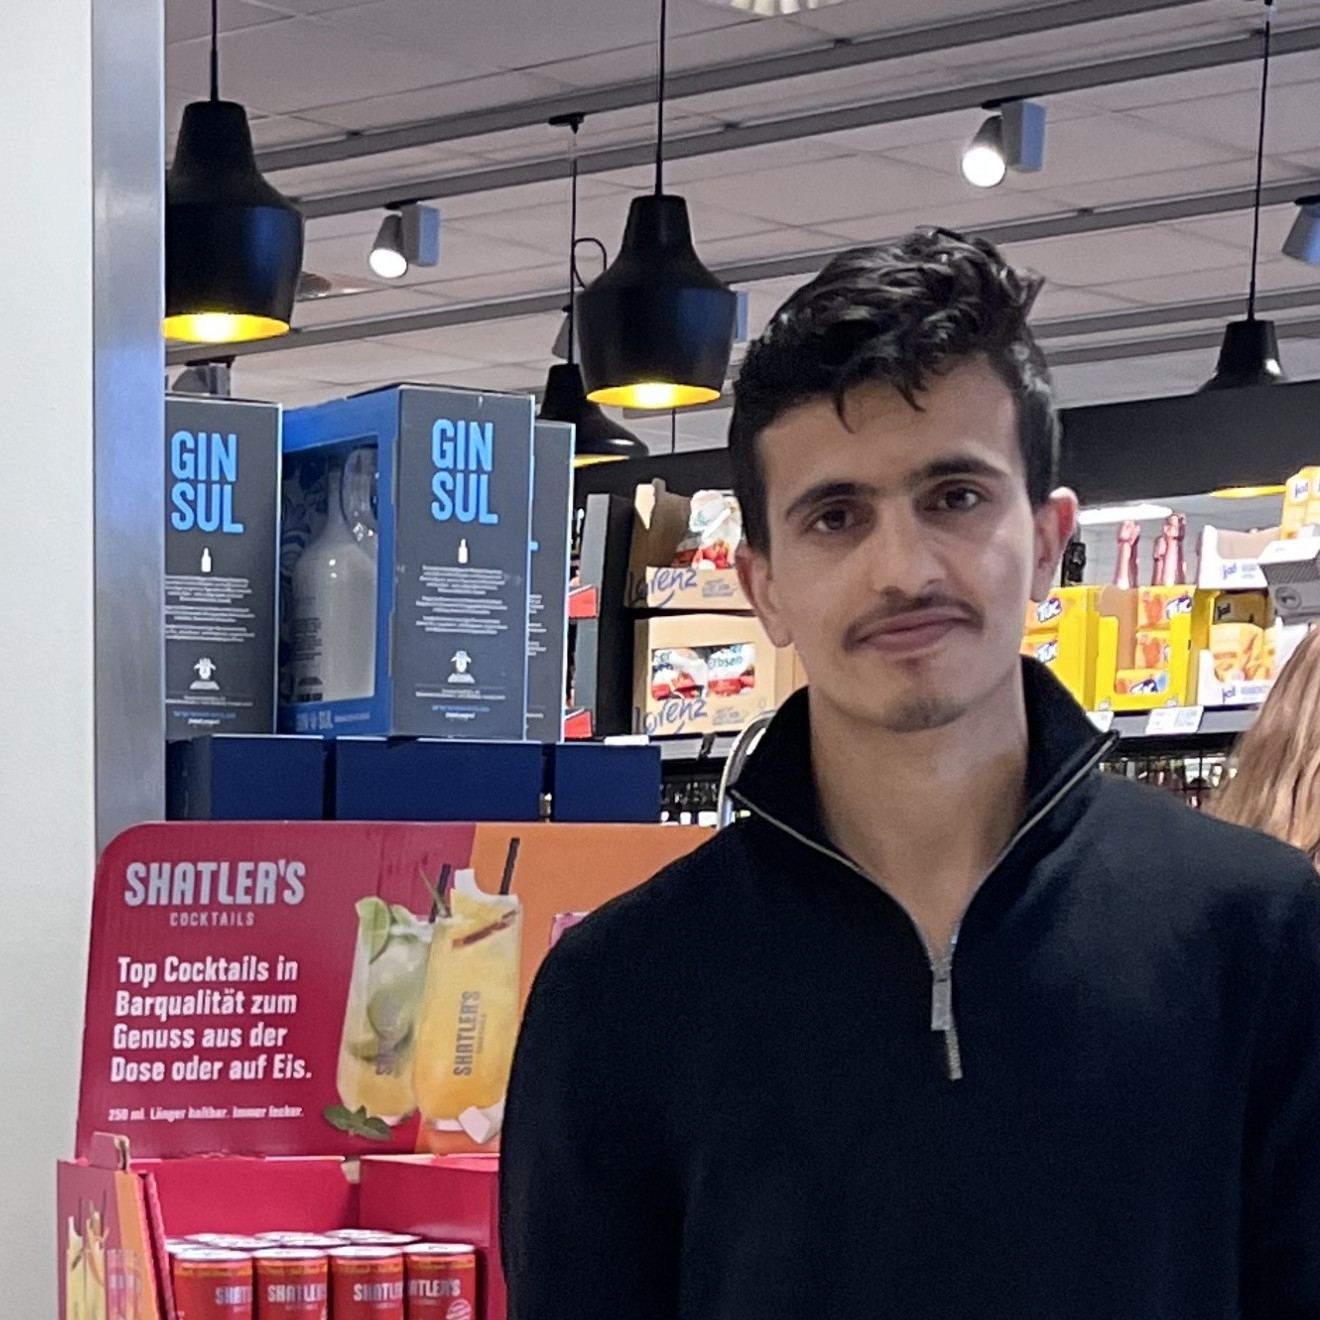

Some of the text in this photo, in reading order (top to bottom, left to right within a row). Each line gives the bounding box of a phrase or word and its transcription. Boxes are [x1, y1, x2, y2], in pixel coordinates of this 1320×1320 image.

[171, 431, 237, 482] GIN
[431, 418, 494, 471] GIN
[171, 483, 244, 534] SUL
[431, 471, 498, 525] SUL
[125, 859, 306, 906] SHATLER'S
[170, 911, 255, 926] COCKTAILS
[117, 955, 298, 985] Top Cocktails in
[115, 988, 297, 1021] Barqualität zum
[113, 1022, 287, 1050] Genuss aus der
[110, 1054, 312, 1083] Dose oder auf Eis.
